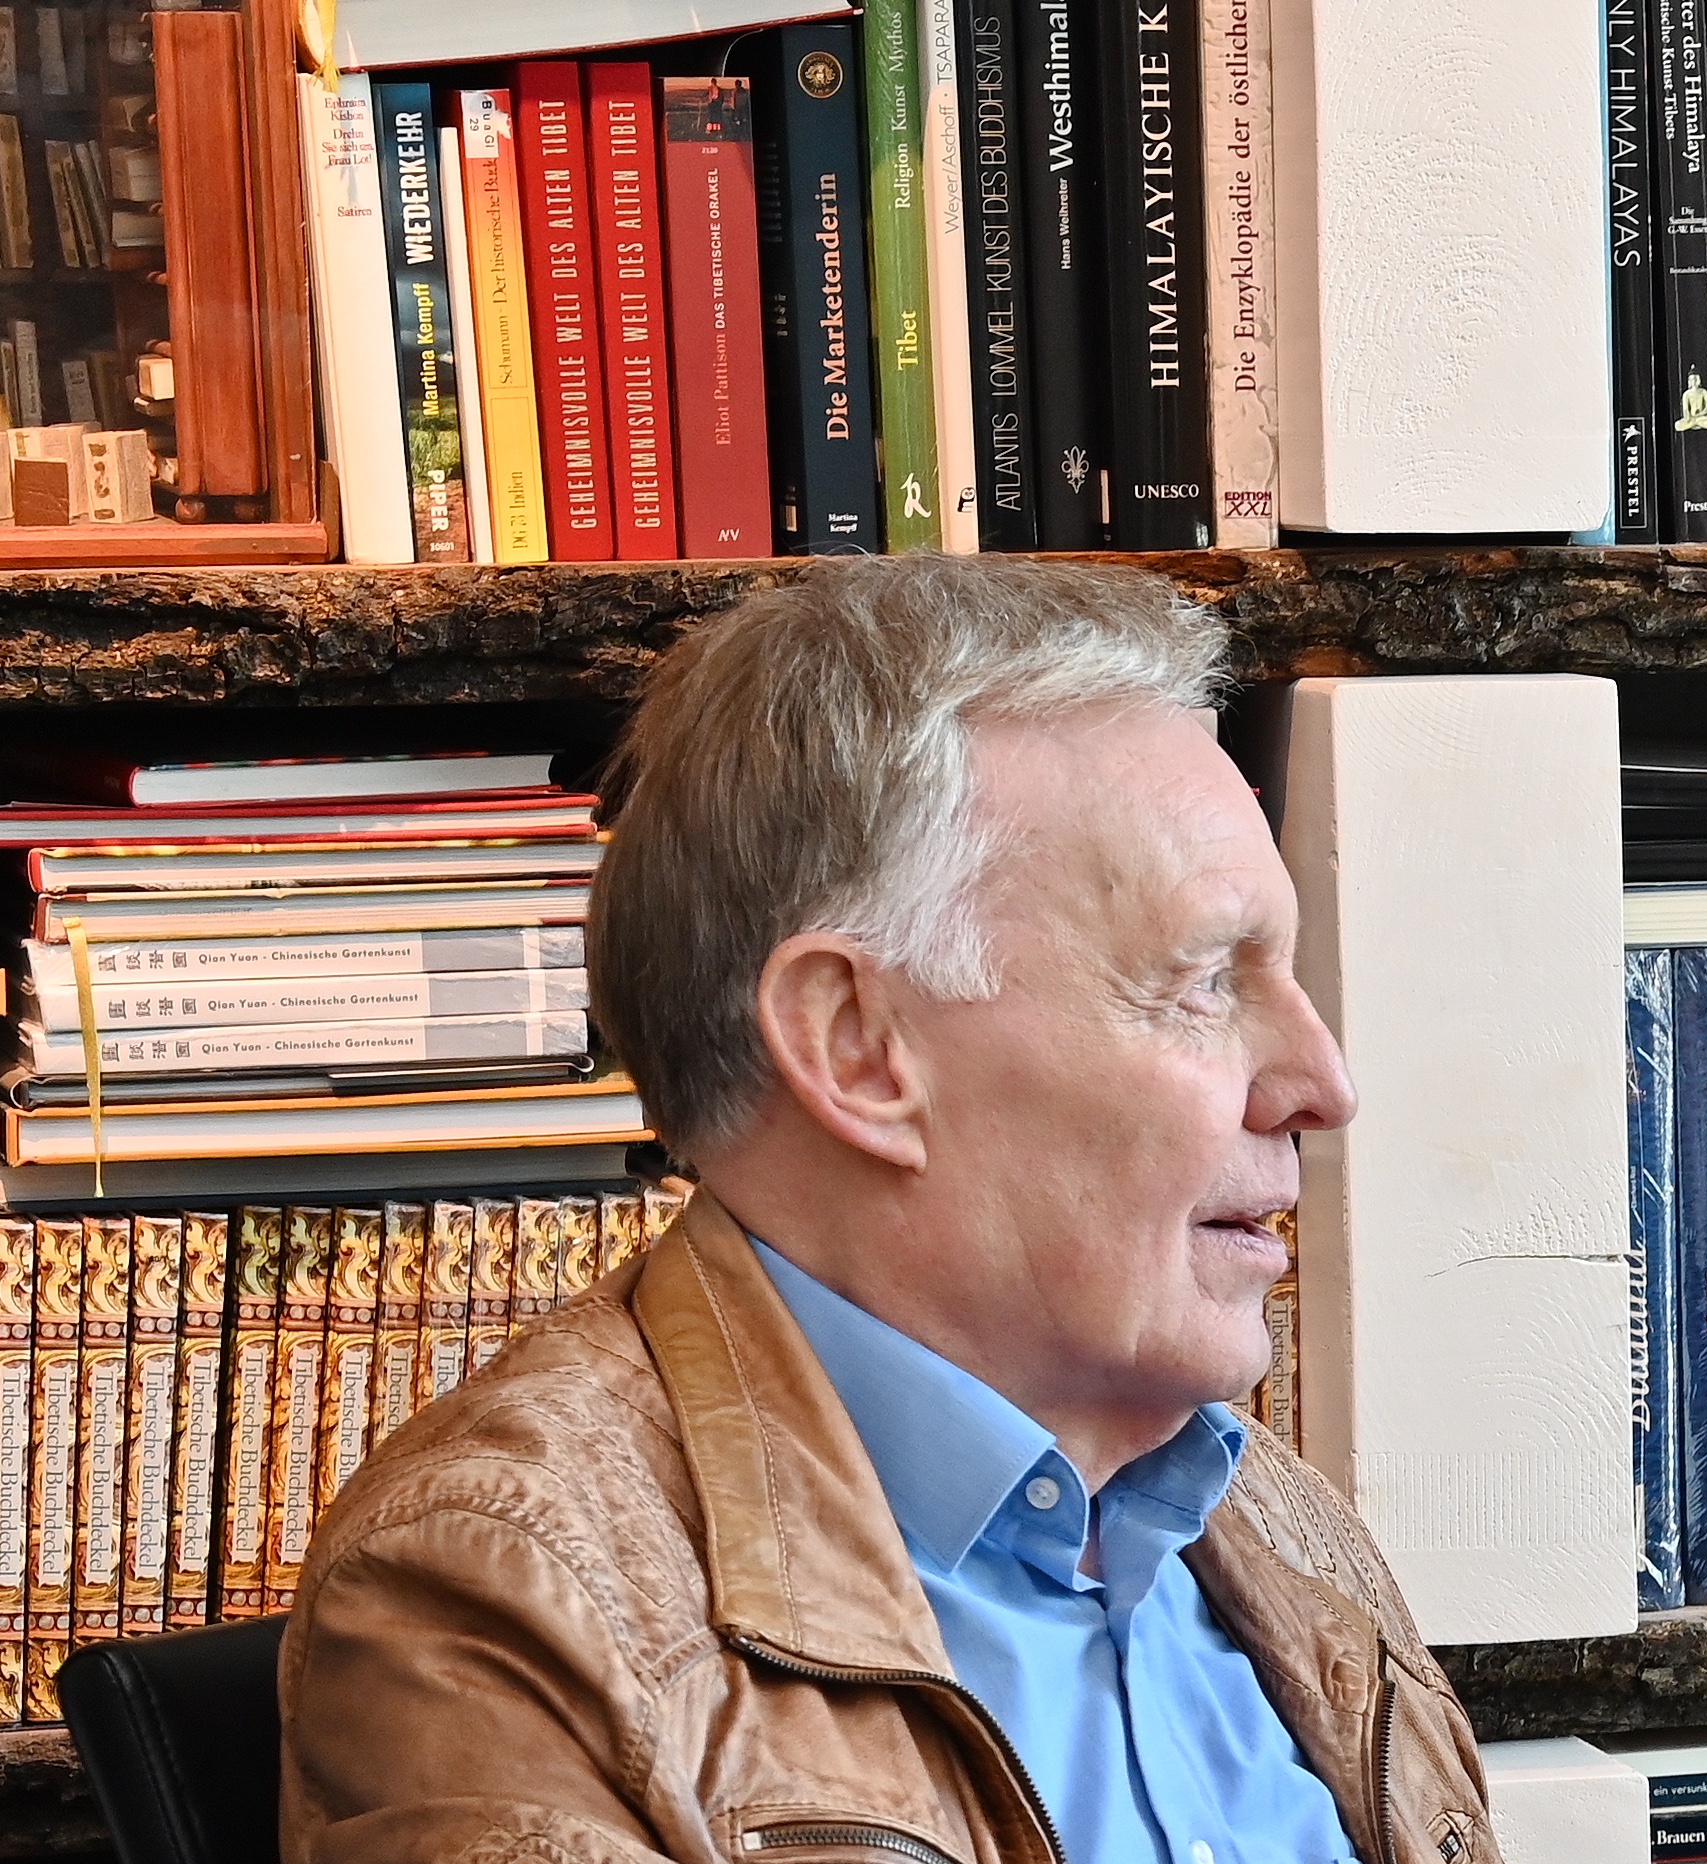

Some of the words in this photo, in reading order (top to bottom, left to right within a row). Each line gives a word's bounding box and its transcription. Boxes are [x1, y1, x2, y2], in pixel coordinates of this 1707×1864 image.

[889, 12, 907, 73] Mythos
[1682, 37, 1701, 70] des
[891, 85, 908, 131] Kunst
[974, 16, 1007, 165] BUDDHISMUS
[539, 100, 568, 155] TIBET
[1228, 118, 1250, 159] der
[1682, 74, 1706, 174] Himalaya
[395, 112, 434, 265] WIEDERKEHR
[708, 167, 721, 219] ORAKEL
[893, 142, 914, 210] Religion
[980, 170, 1010, 214] DES
[1609, 69, 1641, 267] HIMALAYAS
[337, 206, 372, 217] Satiren
[544, 169, 574, 229] ALTEN
[1138, 53, 1180, 389] HIMALAYISCHE
[549, 242, 578, 279] DES
[709, 222, 725, 299] TIBETISCHE
[814, 173, 848, 386] Marketenderin
[982, 218, 1012, 292] KUNST
[1229, 172, 1262, 340] Enzyklopädie
[413, 283, 434, 345] Kempff
[553, 292, 583, 344] WELT
[715, 303, 727, 329] DAS
[896, 311, 918, 371] Tibet
[987, 301, 1017, 396] LOMMEL
[1235, 351, 1256, 393] Die
[422, 349, 439, 416] Martina
[558, 355, 598, 530] GEHEIMNISVOLLE
[824, 392, 850, 440] Die
[991, 411, 1021, 512] ATLANTIS
[1134, 484, 1199, 499] UNESCO
[1627, 444, 1640, 518] PRESTEL
[427, 469, 449, 532] PIPER
[1225, 491, 1272, 500] EDITION
[1226, 501, 1271, 518] XXL
[198, 953, 226, 966] Qian
[271, 949, 338, 961] Chinesische
[342, 947, 411, 960] Gartenkunst
[45, 1372, 67, 1466] Tibetische
[241, 1353, 264, 1446] Tibetische
[42, 1471, 64, 1576] Buchdeckel
[235, 1449, 258, 1552] Buchdeckel
[1654, 1786, 1668, 1797] ein
[1657, 1829, 1705, 1846] Brauen
